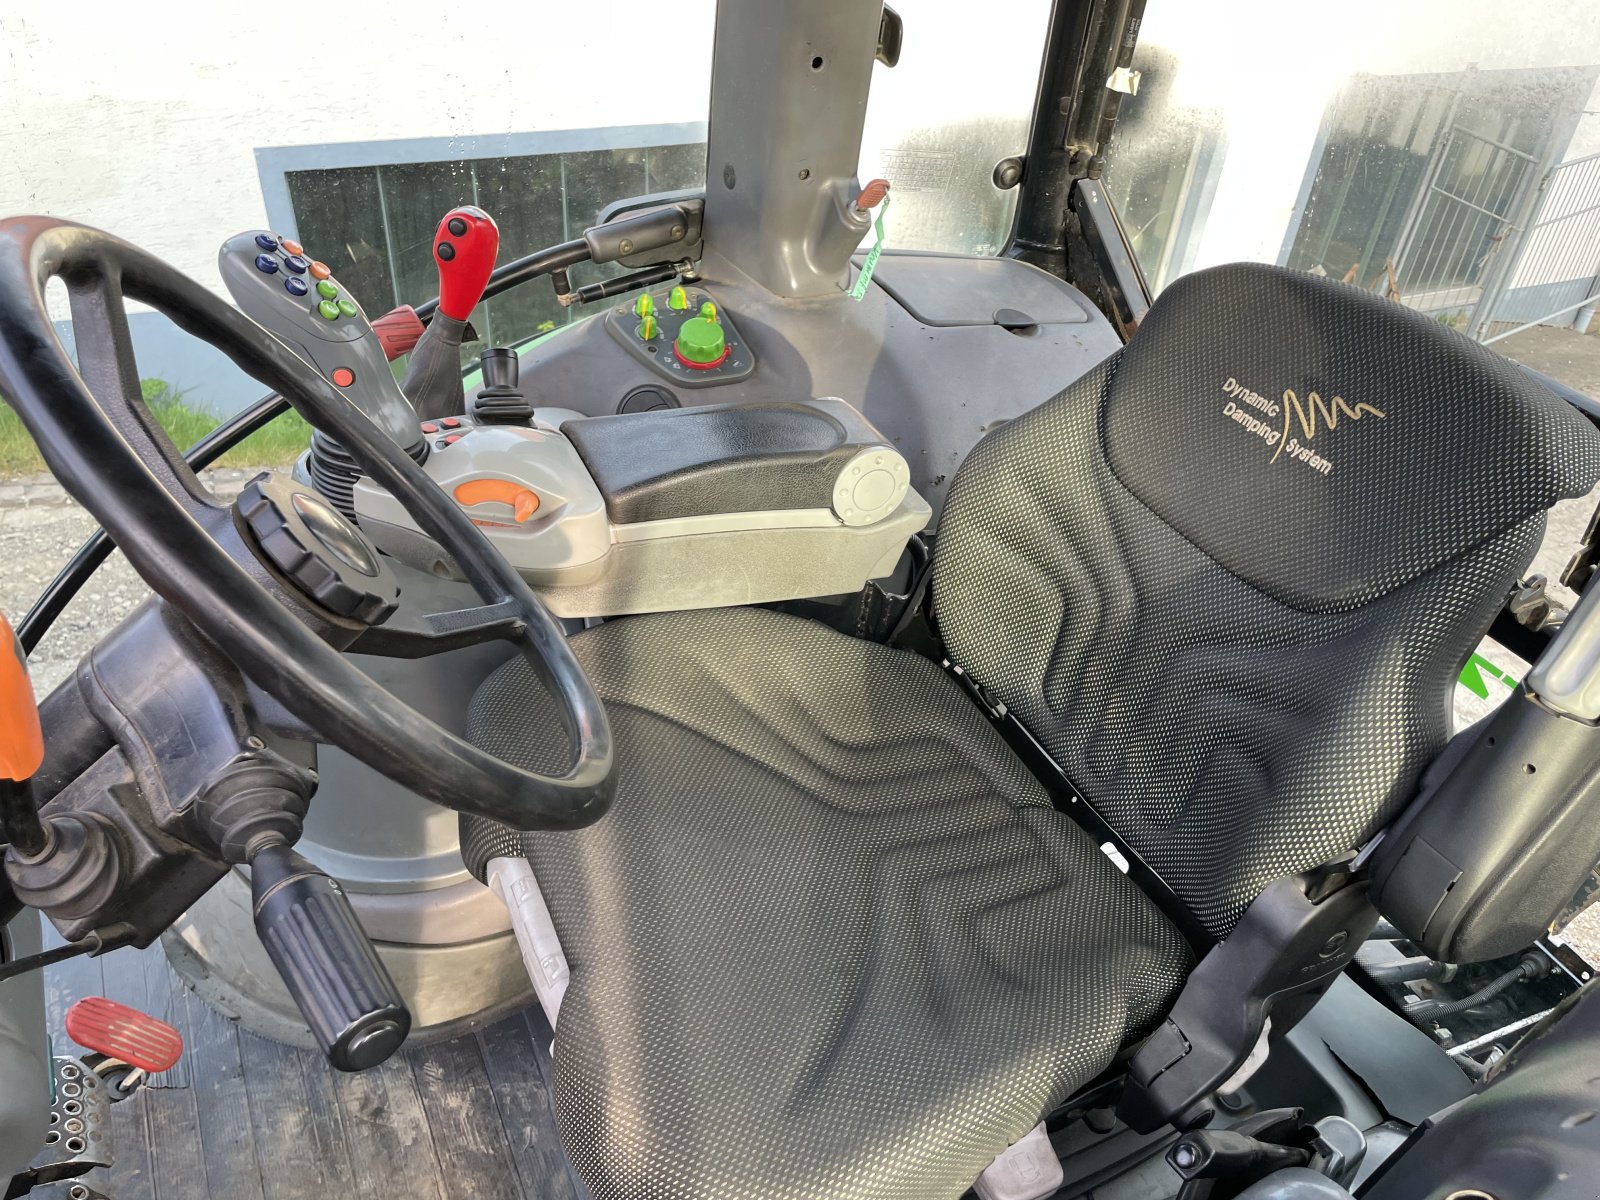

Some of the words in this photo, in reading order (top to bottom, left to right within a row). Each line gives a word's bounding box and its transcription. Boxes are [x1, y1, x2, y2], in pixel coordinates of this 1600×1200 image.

[1222, 377, 1280, 417] Dynamic
[1222, 402, 1281, 445] Damping
[1285, 438, 1333, 475] System
